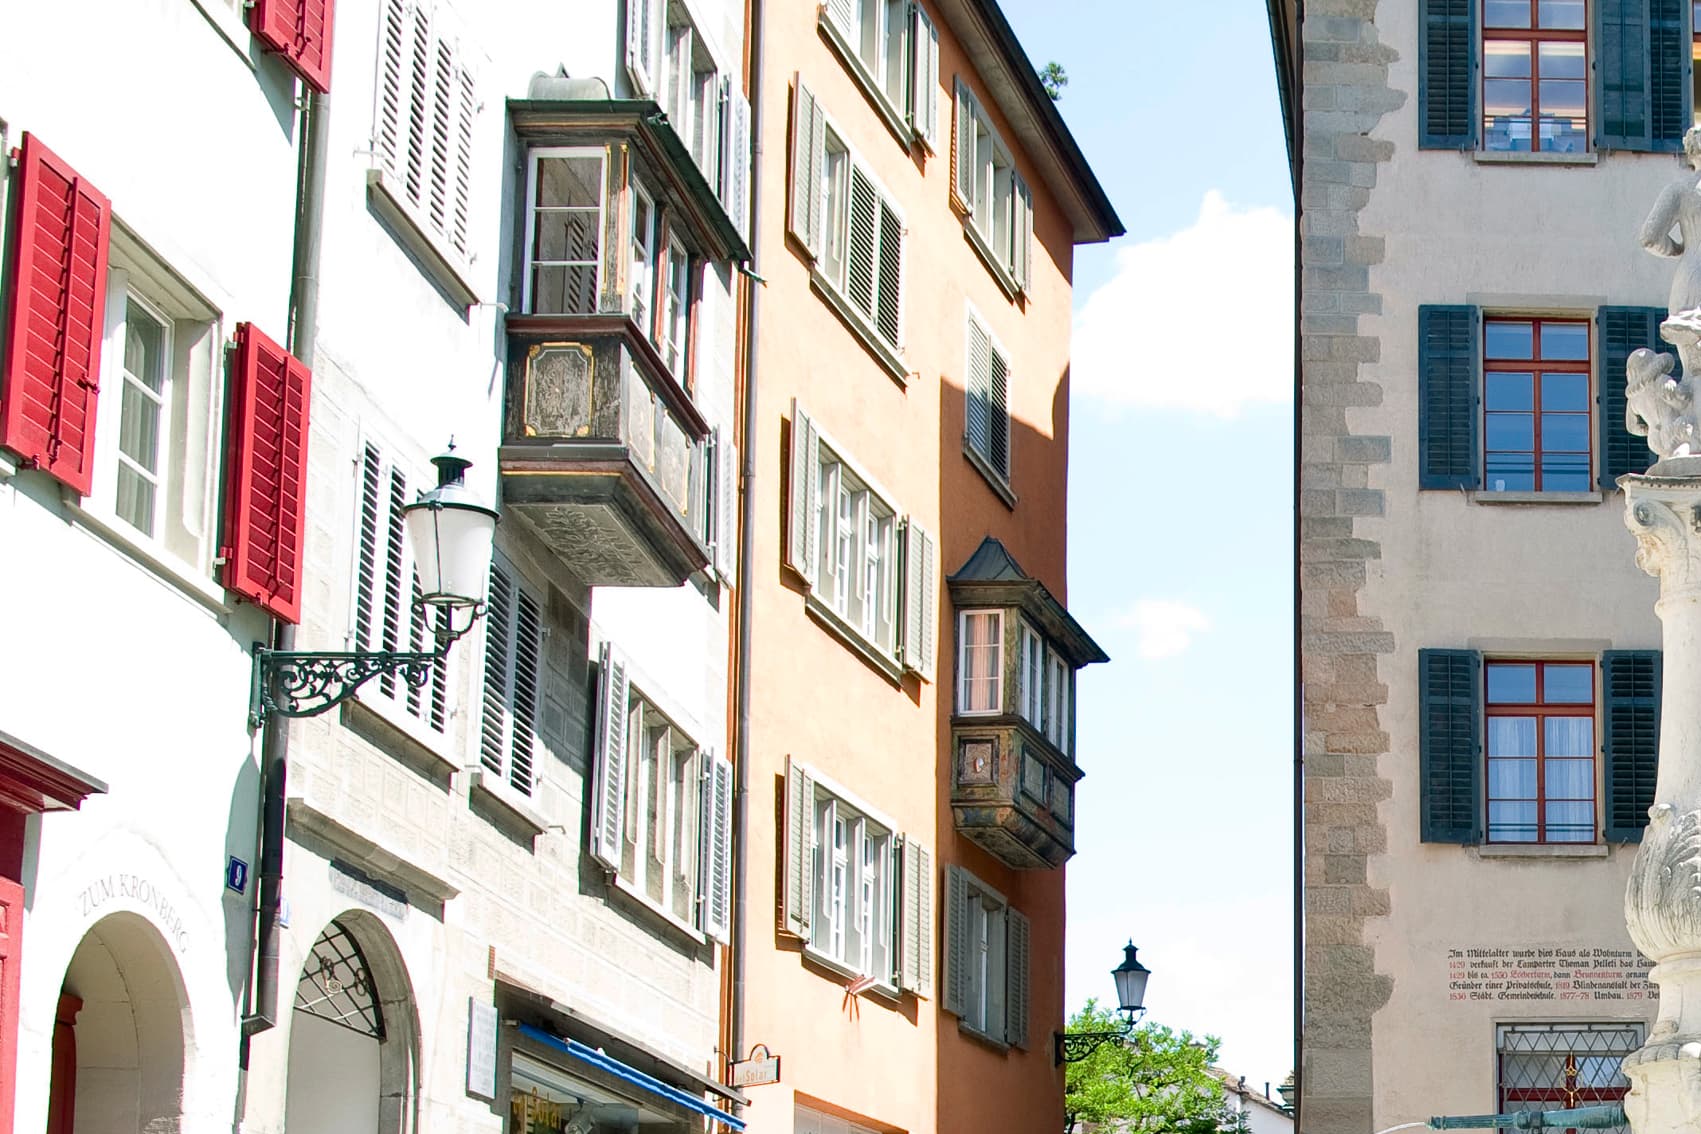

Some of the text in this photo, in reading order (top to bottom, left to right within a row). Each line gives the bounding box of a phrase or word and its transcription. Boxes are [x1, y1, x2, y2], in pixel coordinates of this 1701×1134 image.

[234, 864, 243, 887] 9
[78, 873, 191, 954] ZUM KRONBERG
[1448, 949, 1463, 958] Im
[1467, 949, 1509, 958] Mittelalter
[1512, 949, 1535, 958] wurde
[1538, 949, 1553, 958] dies
[1555, 949, 1576, 958] Haus
[1579, 949, 1590, 958] als
[1592, 949, 1632, 958] Wohnturm
[1470, 960, 1498, 969] verkauft
[1502, 960, 1514, 969] der
[1619, 959, 1633, 969] das
[1553, 970, 1571, 979] dann
[1449, 980, 1482, 991] Gründer
[1485, 980, 1503, 991] einer
[1572, 980, 1628, 990] Blindenanstalt
[1630, 980, 1640, 990] der
